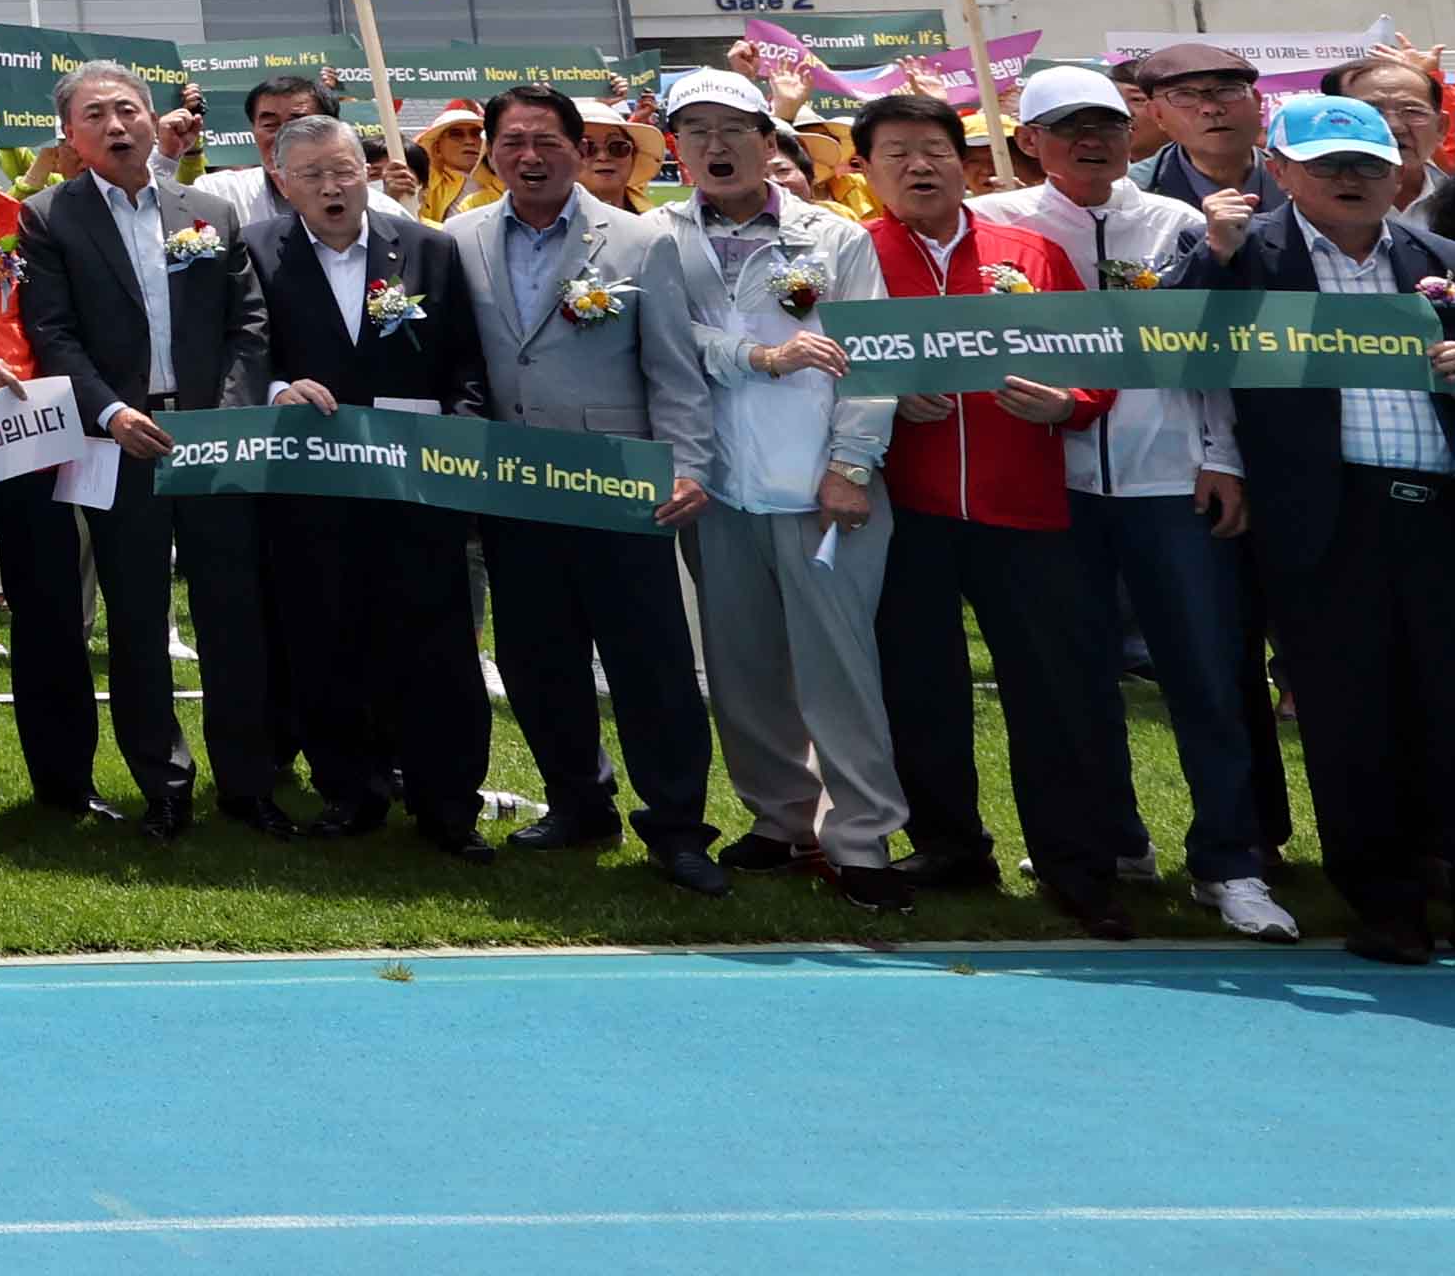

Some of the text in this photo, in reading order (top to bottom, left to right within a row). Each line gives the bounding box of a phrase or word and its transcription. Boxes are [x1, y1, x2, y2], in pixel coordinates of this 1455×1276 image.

[802, 33, 865, 48] Summit
[209, 56, 259, 70] Summit
[337, 69, 372, 82] 2025
[419, 68, 477, 82] Summit
[552, 67, 611, 82] Incheon
[845, 324, 1423, 362] 2025 APEC Summit Now, it's Incheon
[171, 436, 655, 502] 2025 APEC Summit Now, it's Incheon
